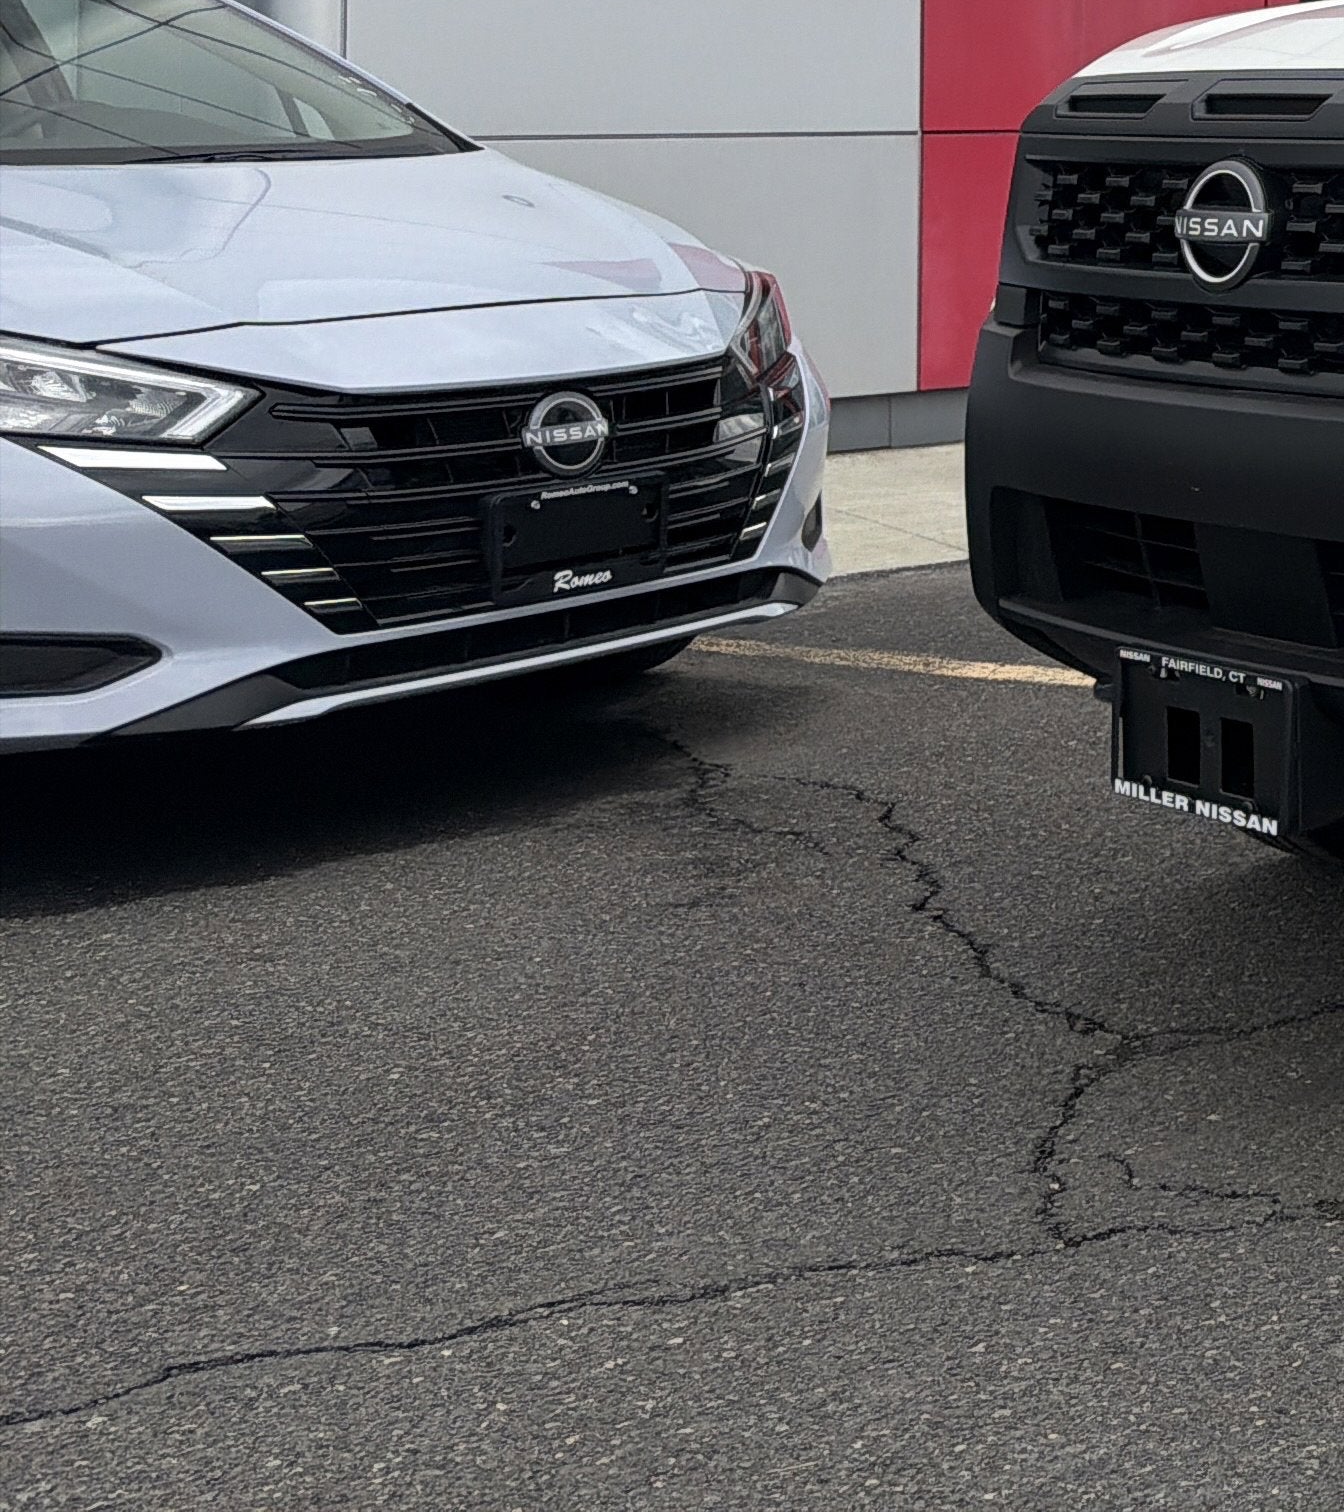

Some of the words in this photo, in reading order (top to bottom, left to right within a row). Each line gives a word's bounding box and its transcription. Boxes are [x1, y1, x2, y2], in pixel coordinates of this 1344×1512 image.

[1174, 215, 1264, 238] NISSAN
[525, 423, 609, 447] NISSAN
[540, 480, 629, 500] RomeoAutoGroup.com
[552, 569, 614, 593] Romeo
[1119, 649, 1151, 663] NISSAN
[1161, 656, 1226, 682] FAIRFIELD,
[1228, 670, 1247, 684] CT
[1256, 676, 1283, 691] NISSAN
[1114, 778, 1189, 812] MILLER
[1195, 800, 1278, 836] NISSAN
